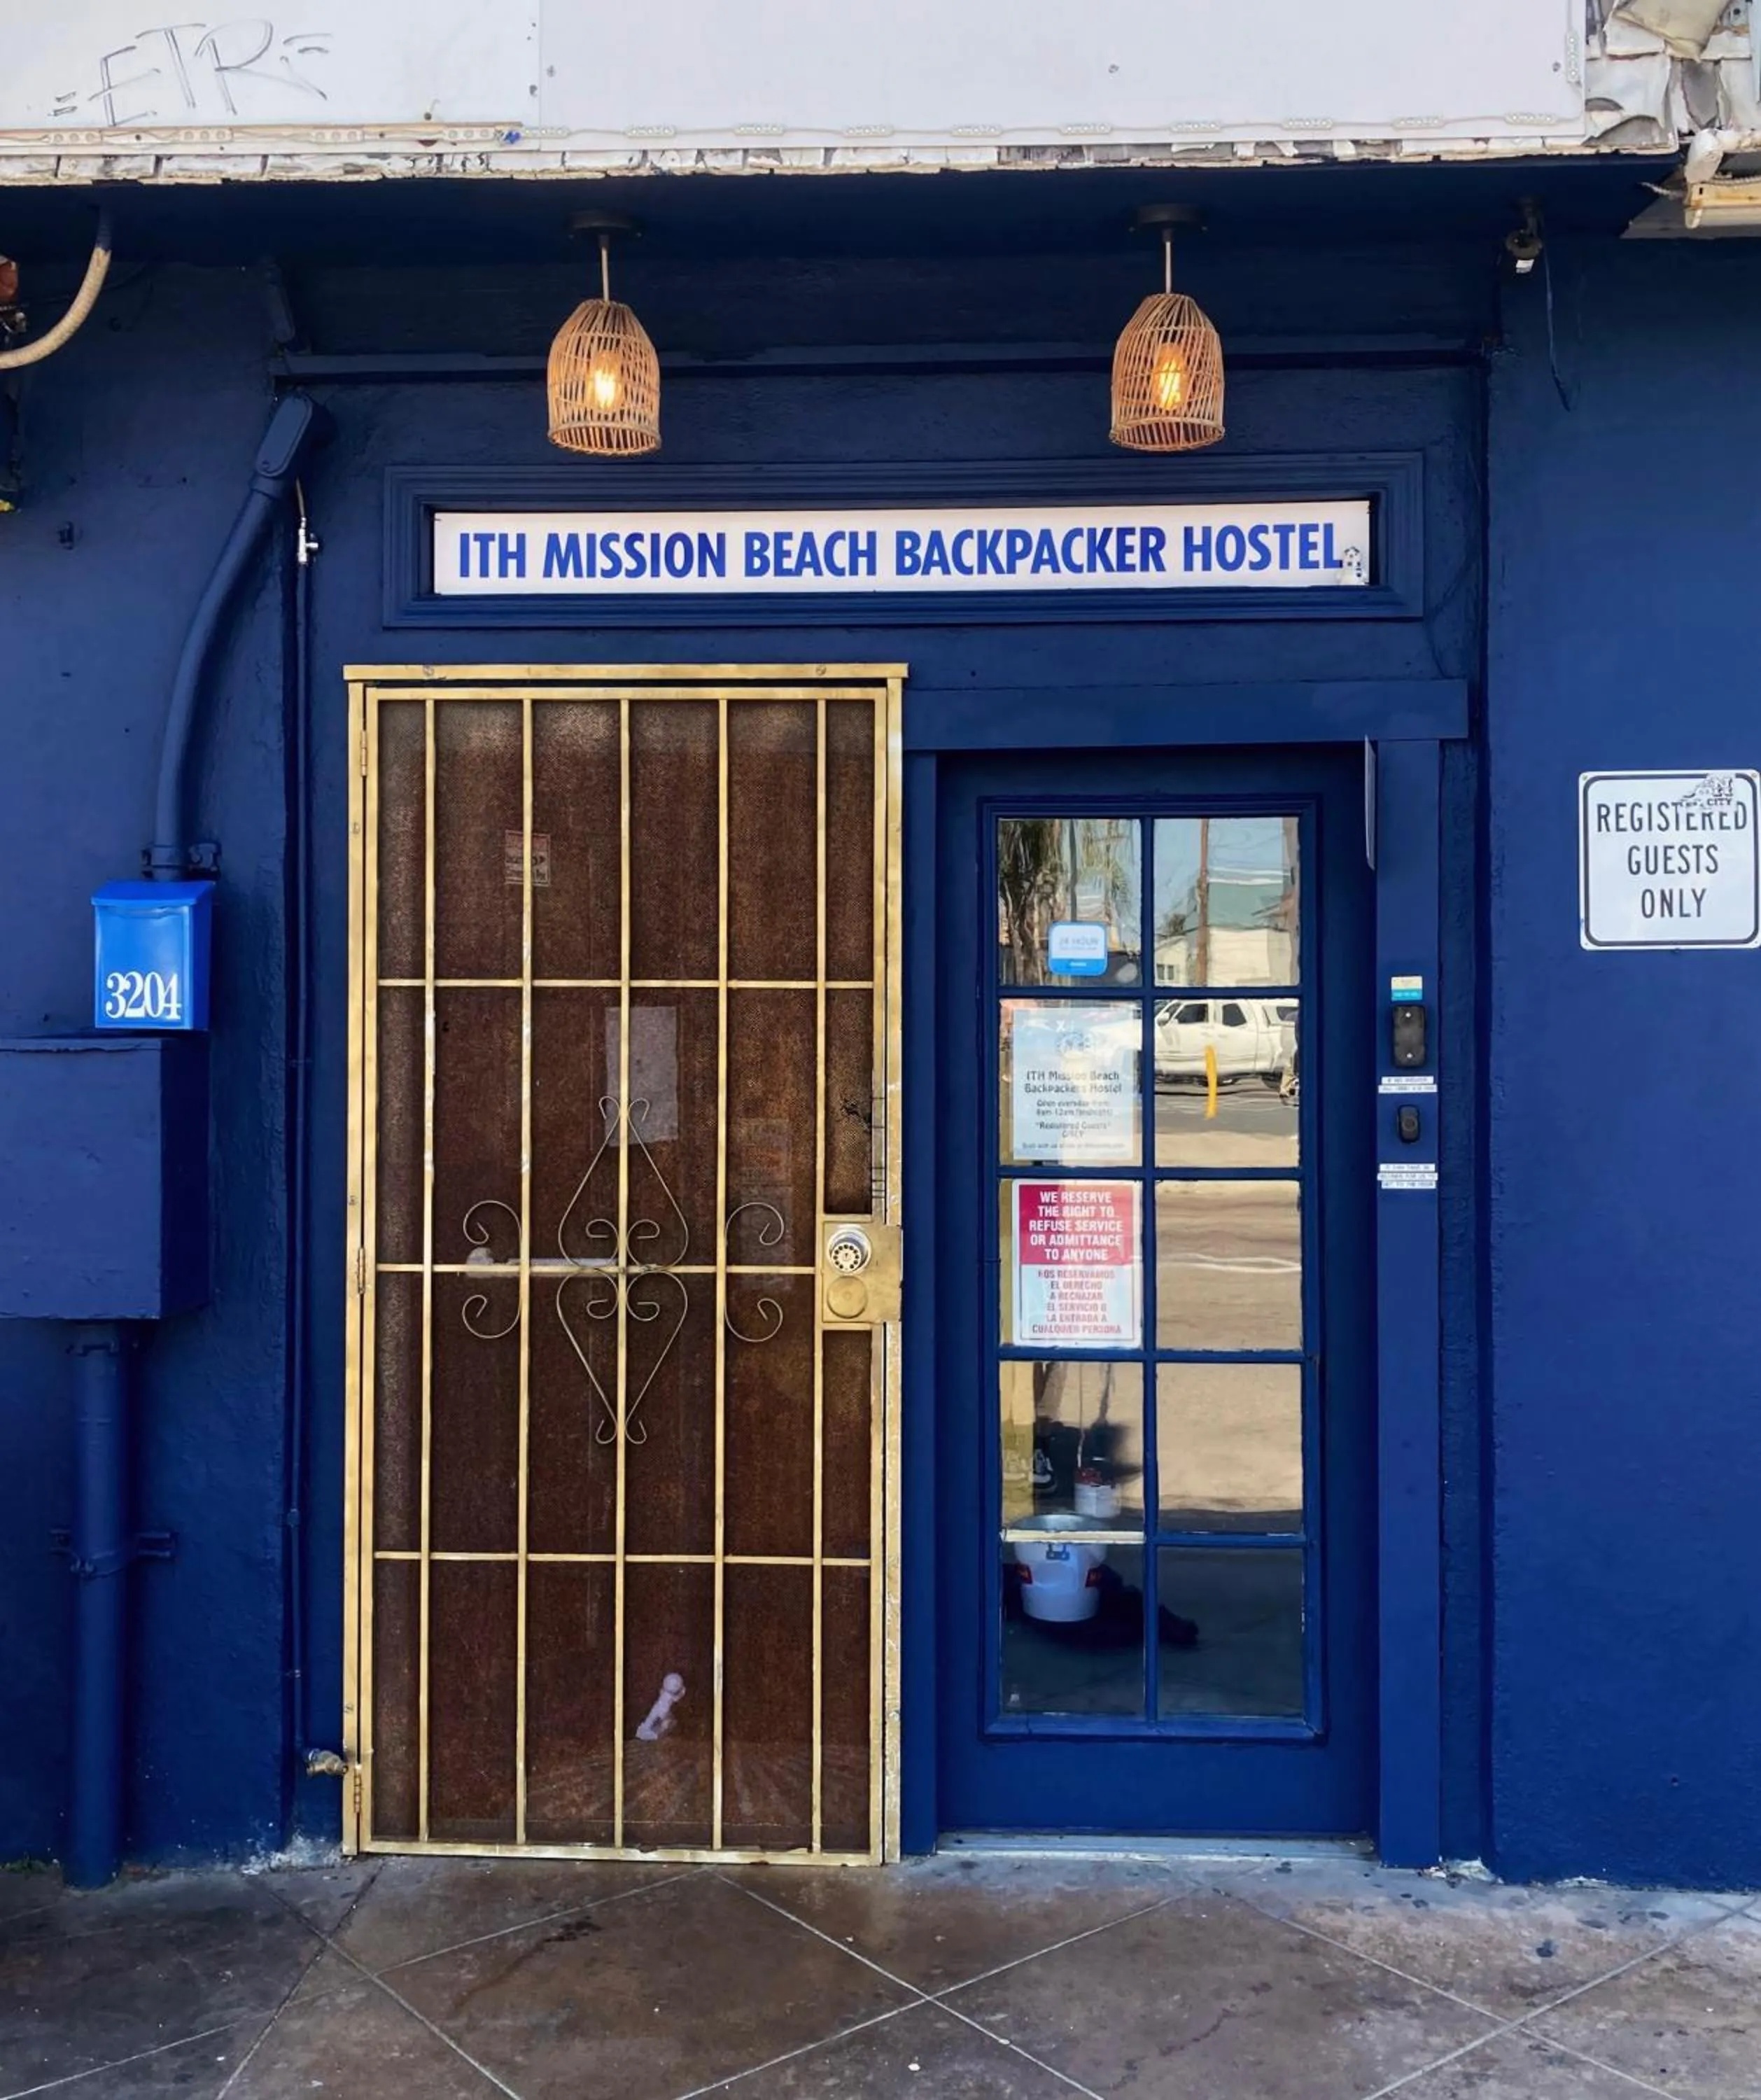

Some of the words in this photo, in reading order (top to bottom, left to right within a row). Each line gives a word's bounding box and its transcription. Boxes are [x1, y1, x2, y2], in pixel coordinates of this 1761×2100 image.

[459, 532, 526, 578] ITH
[542, 532, 727, 579] MISSION
[743, 531, 877, 578] BEACH
[896, 526, 1167, 576] BACKPACKER
[1184, 523, 1343, 571] HOSTEL
[1597, 802, 1747, 833] REGISTERED
[1627, 844, 1719, 876] GUESTS
[1641, 888, 1706, 918] ONLY
[106, 971, 182, 1020] 3204
[1027, 1070, 1045, 1080] ITH
[1090, 1070, 1119, 1080] Beach
[1090, 1083, 1122, 1093] Hostel
[1039, 1191, 1058, 1203] WE
[1061, 1191, 1112, 1203] RESERVE
[1038, 1205, 1059, 1217] THE
[1062, 1205, 1095, 1217] RIGHT
[1100, 1205, 1115, 1217] TO
[1029, 1219, 1072, 1231] REFUSE
[1074, 1219, 1123, 1232] SERVICE
[1030, 1233, 1046, 1245] OR
[1049, 1233, 1122, 1246] ADMITTANCE
[1044, 1248, 1059, 1260] TO
[1062, 1248, 1109, 1261] ANYONE
[1051, 1280, 1059, 1289] EL
